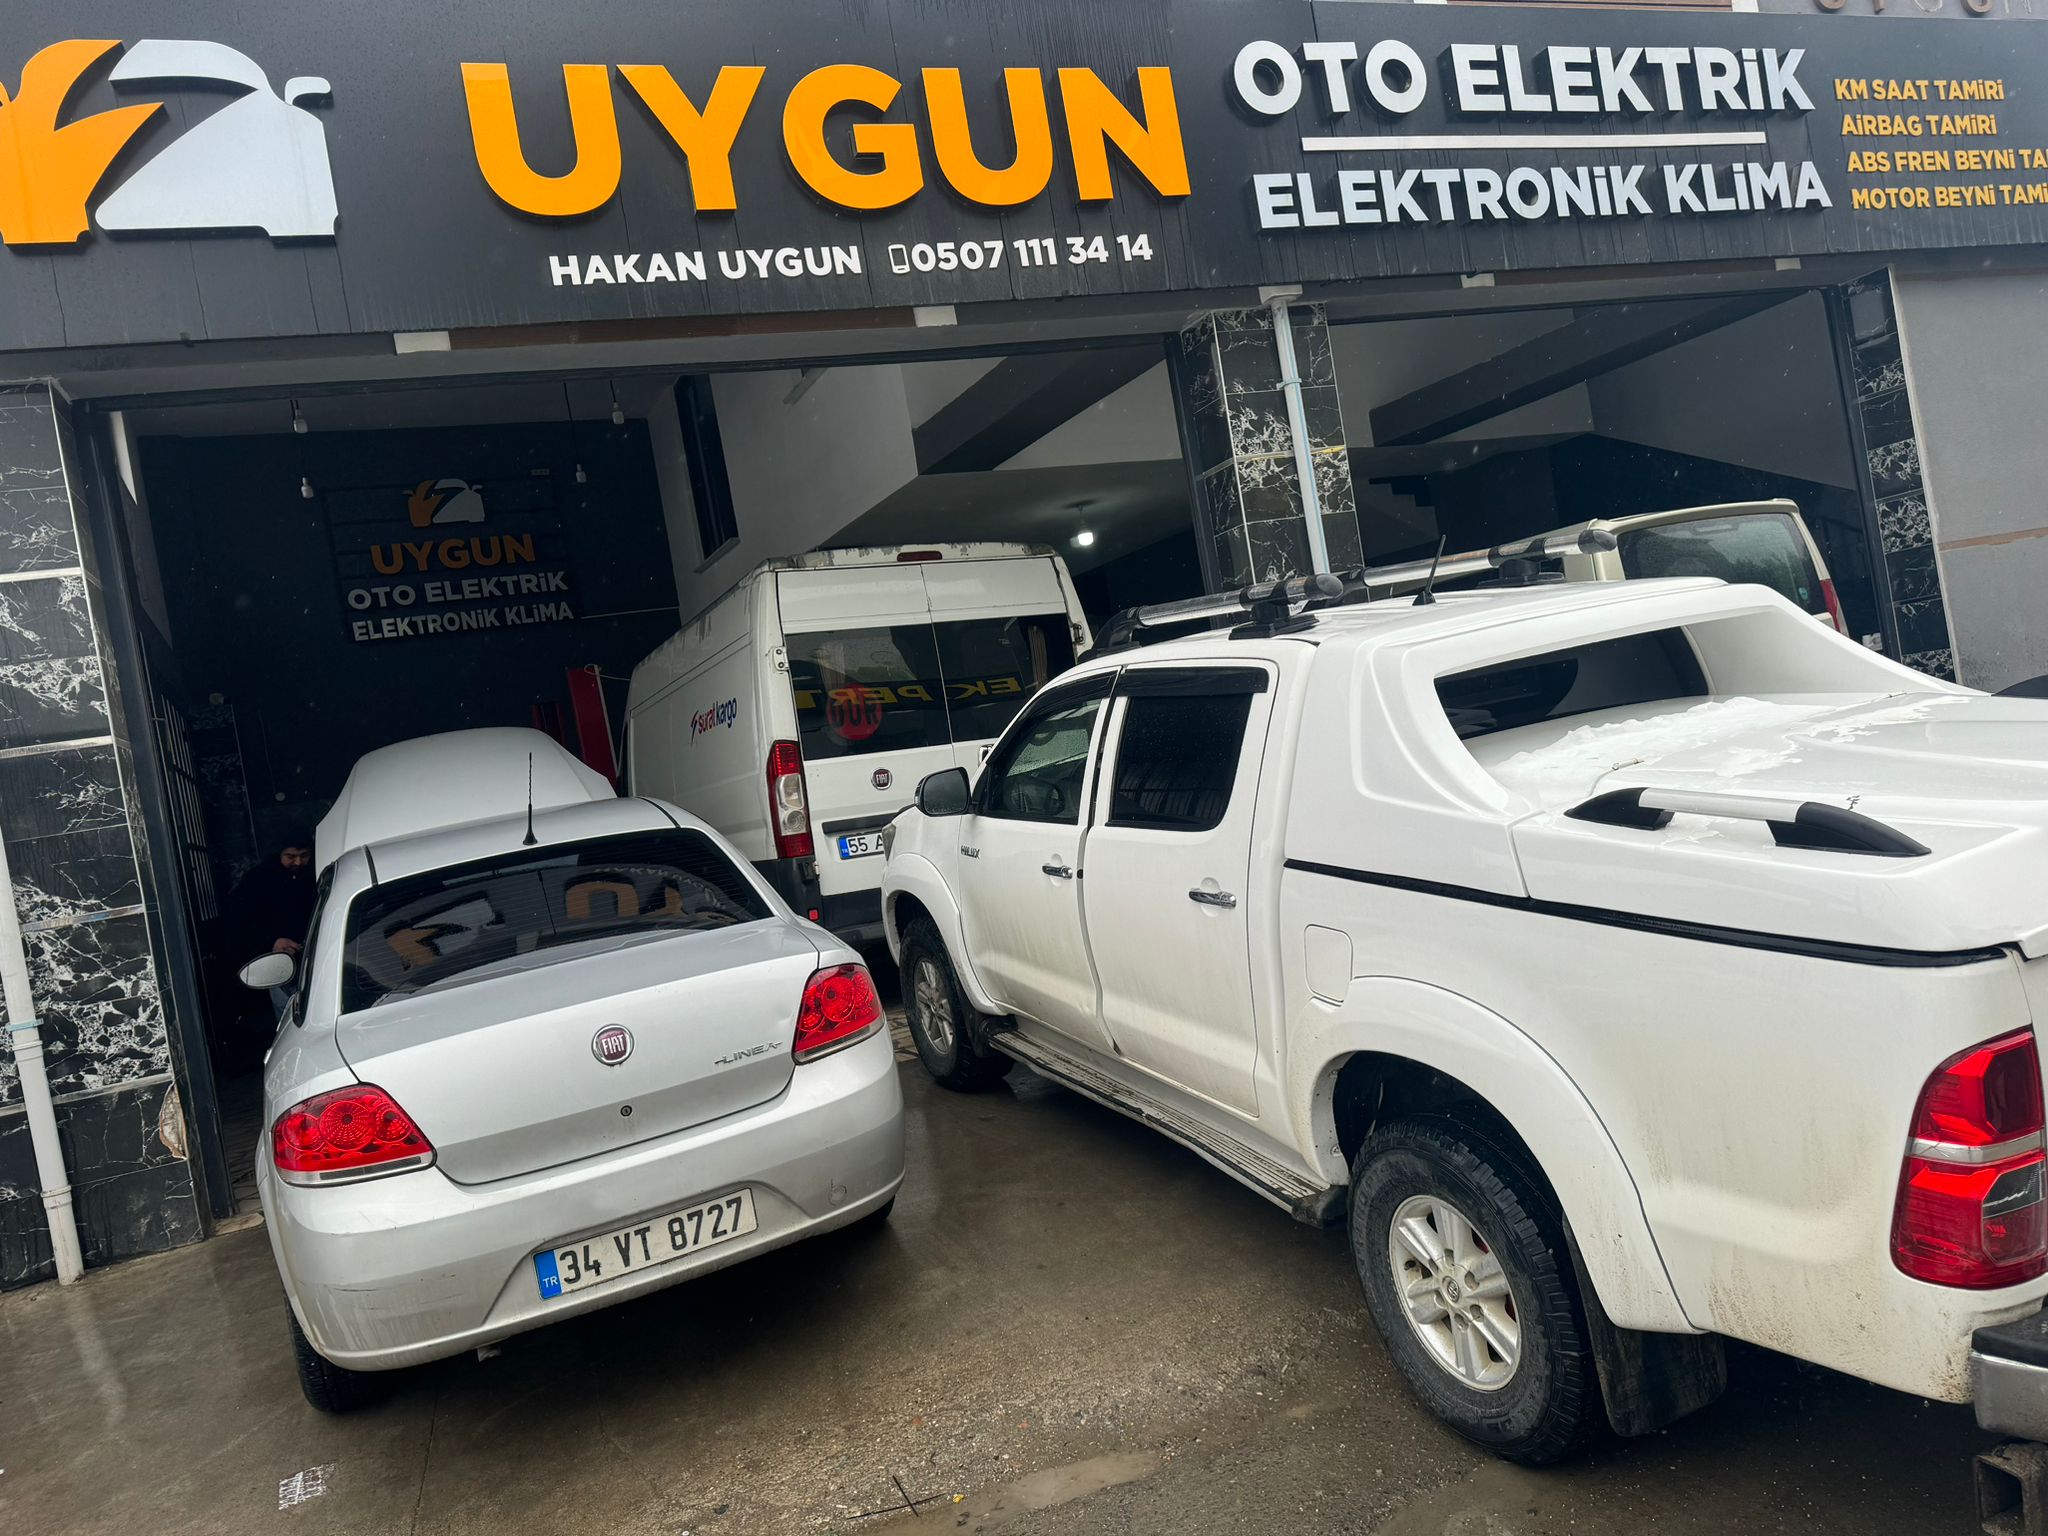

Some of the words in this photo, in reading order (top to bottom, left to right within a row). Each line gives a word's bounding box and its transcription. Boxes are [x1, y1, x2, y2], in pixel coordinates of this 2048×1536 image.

[1233, 39, 1427, 115] OTO
[1834, 78, 1869, 100] KM
[1872, 79, 1929, 100] SAAT
[460, 62, 1191, 216] UYGUN
[1847, 151, 1891, 172] ABS
[1893, 151, 1951, 172] FREN
[2018, 148, 2048, 169] TA
[1851, 187, 1931, 209] MOTOR
[549, 250, 707, 286] HAKAN
[718, 245, 862, 280] UYGUN
[911, 240, 1004, 272] 0507
[1013, 237, 1058, 267] 111
[1066, 235, 1109, 265] 34
[1116, 233, 1154, 262] 14
[370, 533, 536, 575] UYGUN
[347, 584, 416, 611] OTO
[875, 772, 888, 785] FIAT
[847, 837, 868, 853] 55
[601, 1033, 626, 1056] FIAT
[714, 1041, 783, 1066] LINEA
[543, 1275, 559, 1289] TR
[559, 1244, 602, 1285] 34
[613, 1225, 651, 1268] VT
[667, 1196, 743, 1251] 8727
